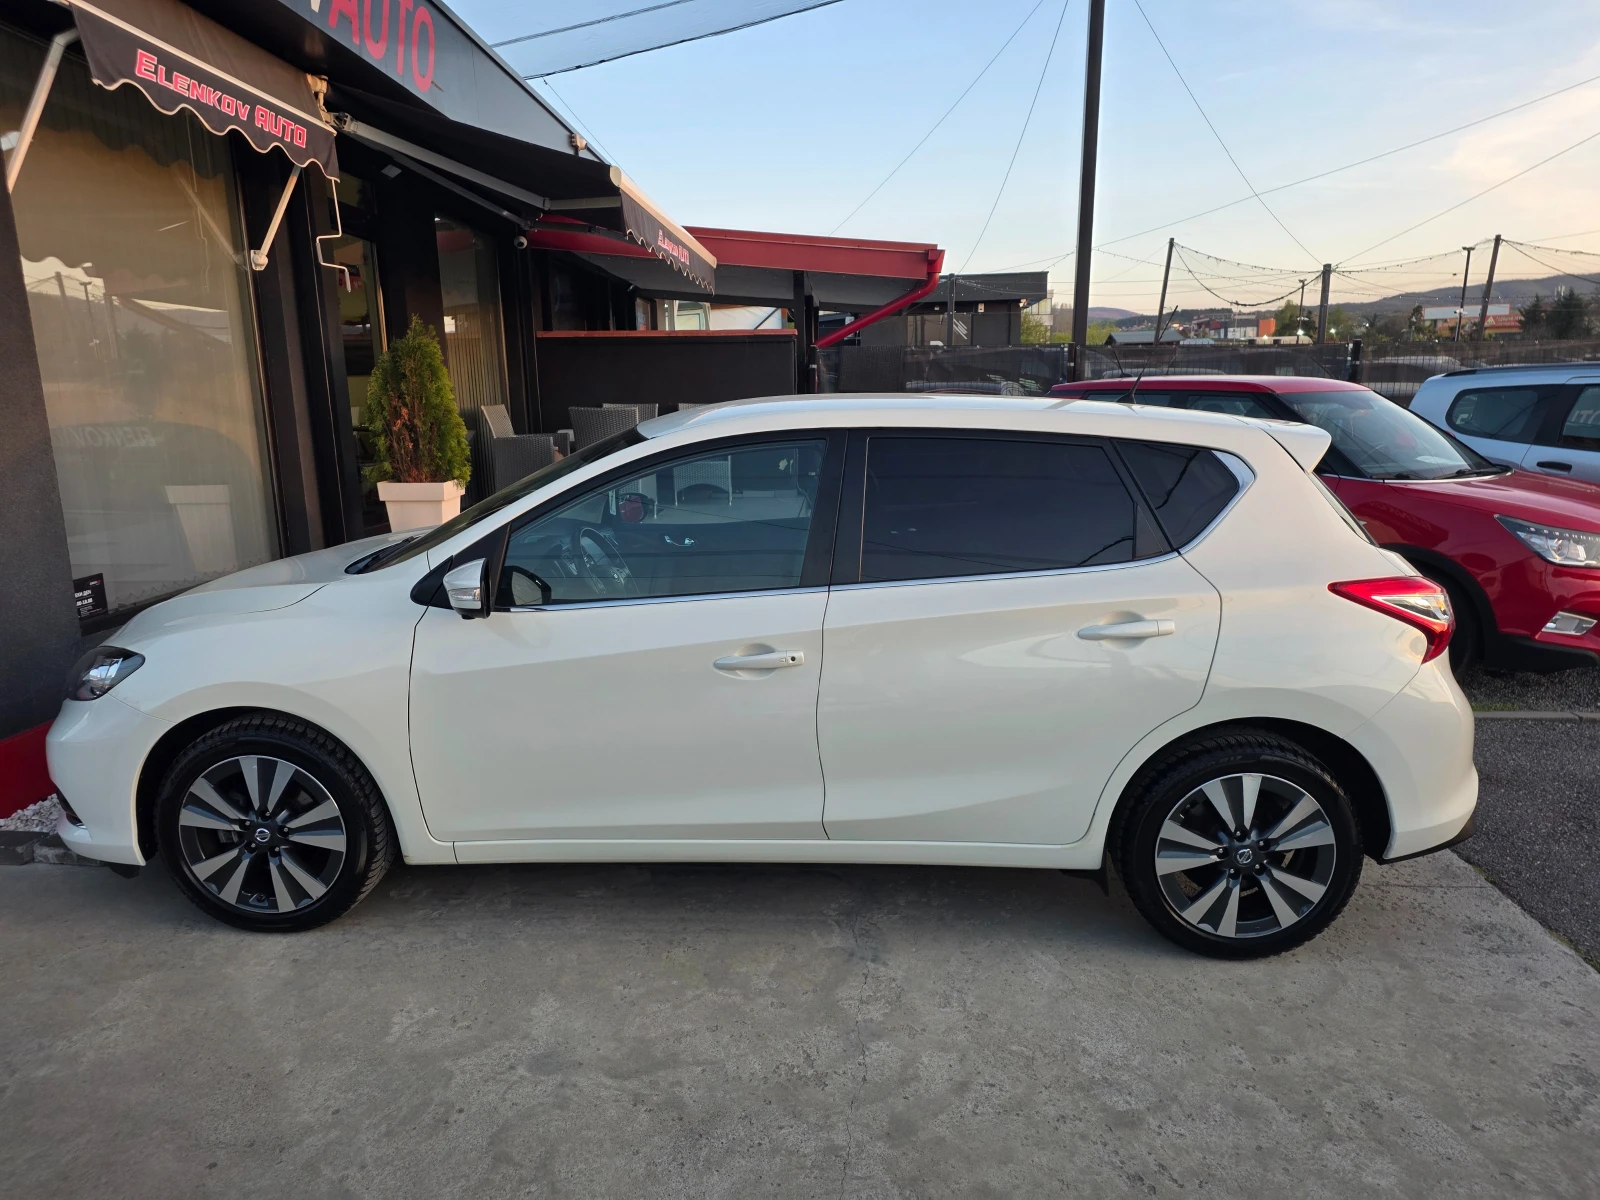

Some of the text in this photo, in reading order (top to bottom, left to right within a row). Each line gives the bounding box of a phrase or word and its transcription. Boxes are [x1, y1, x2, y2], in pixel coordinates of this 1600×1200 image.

[328, 0, 435, 93] AUTO
[135, 48, 307, 149] ELENKOV AUTO
